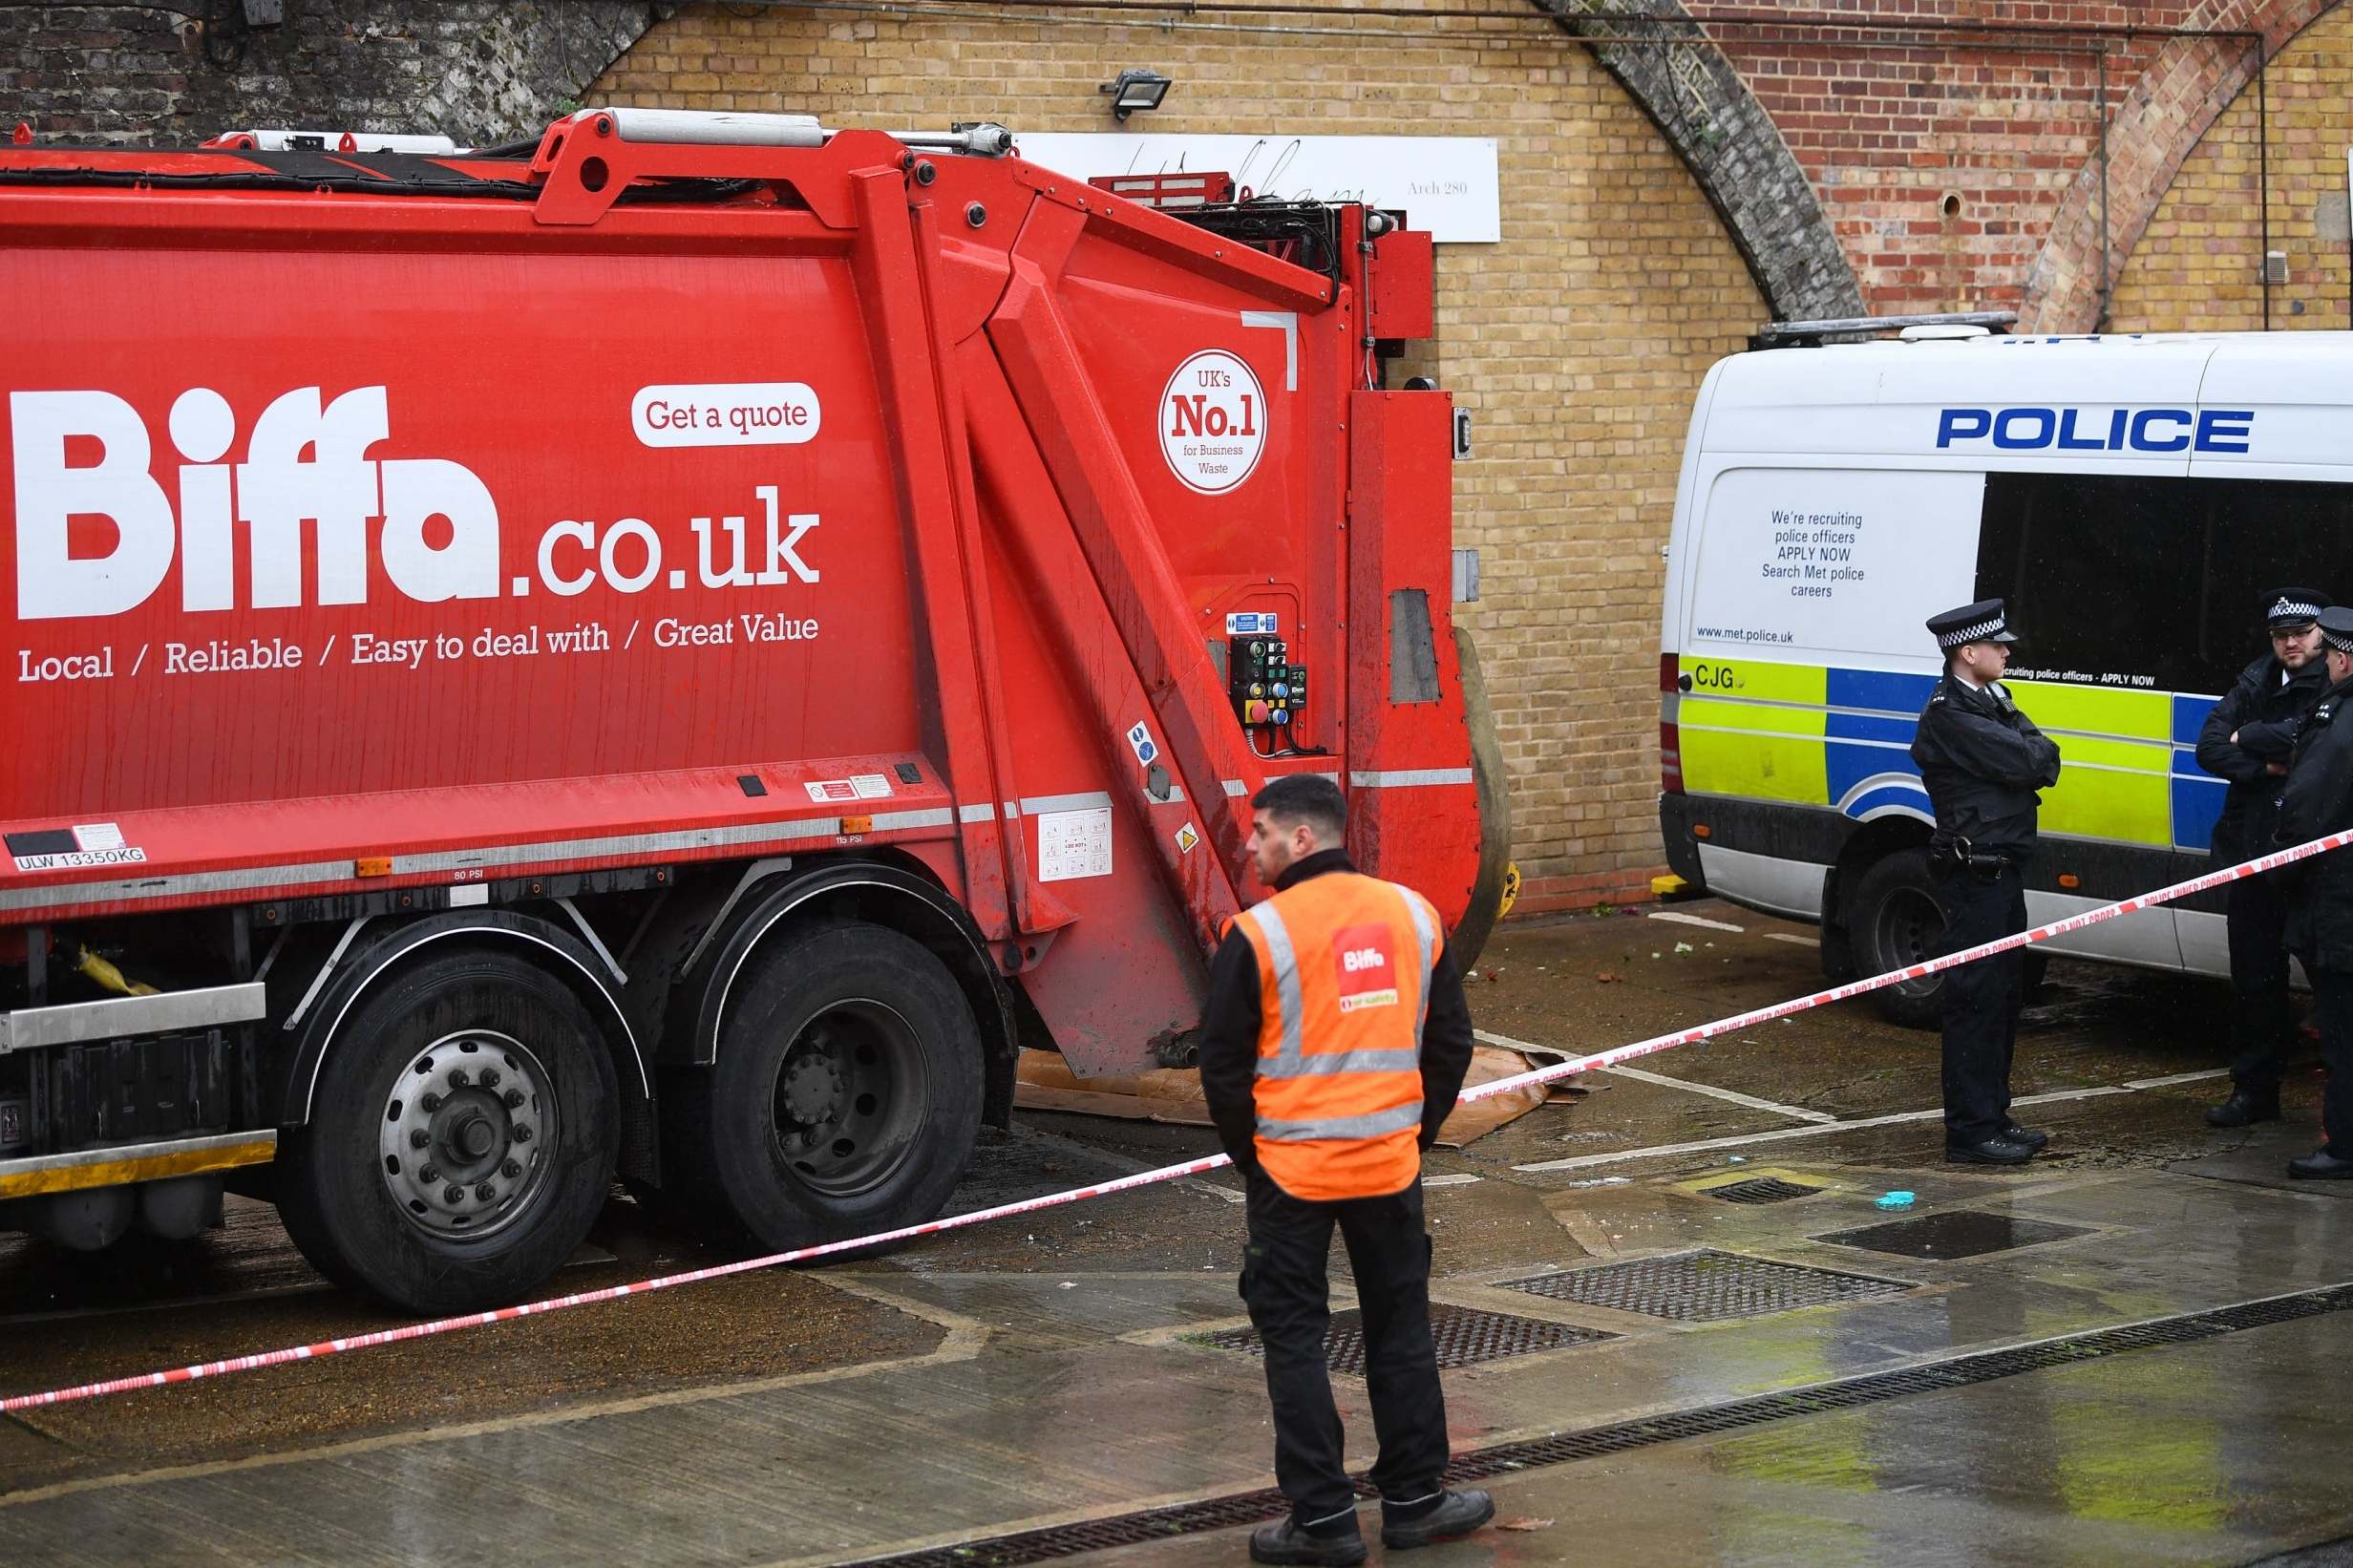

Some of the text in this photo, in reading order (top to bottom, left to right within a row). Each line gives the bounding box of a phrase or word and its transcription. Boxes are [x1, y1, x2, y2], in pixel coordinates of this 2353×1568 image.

[1408, 180, 1467, 195] Arch 280
[1198, 371, 1231, 388] UK's
[646, 400, 808, 435] Get a quote
[1171, 394, 1256, 436] No.1
[1936, 408, 2255, 454] POLICE
[1183, 444, 1243, 456] for Business
[1198, 462, 1228, 475] Waste
[1771, 510, 1863, 529] We're recruiting
[1775, 529, 1855, 545] police officers
[1777, 546, 1852, 562] APPLY NOW
[1762, 563, 1864, 583] Search Met police
[1791, 585, 1833, 598] careers
[1697, 626, 1793, 643] www.met.police.uk
[18, 646, 114, 682] Local
[164, 638, 303, 674] Reliable
[351, 633, 429, 669] Easy
[435, 633, 464, 660] to
[473, 626, 540, 658] deal
[546, 623, 610, 653] with
[654, 618, 734, 648] Great
[741, 613, 819, 643] Value
[1696, 665, 1733, 689] CJG
[2002, 667, 2034, 679] cruiting
[2036, 668, 2060, 680] police
[2062, 669, 2093, 682] officers
[2101, 672, 2130, 685] APPLY
[2131, 675, 2155, 686] NOW
[850, 835, 862, 843] PSI
[19, 849, 143, 870] ULW 13350KG
[454, 870, 483, 879] 80 PSI
[1343, 947, 1385, 972] Biffa
